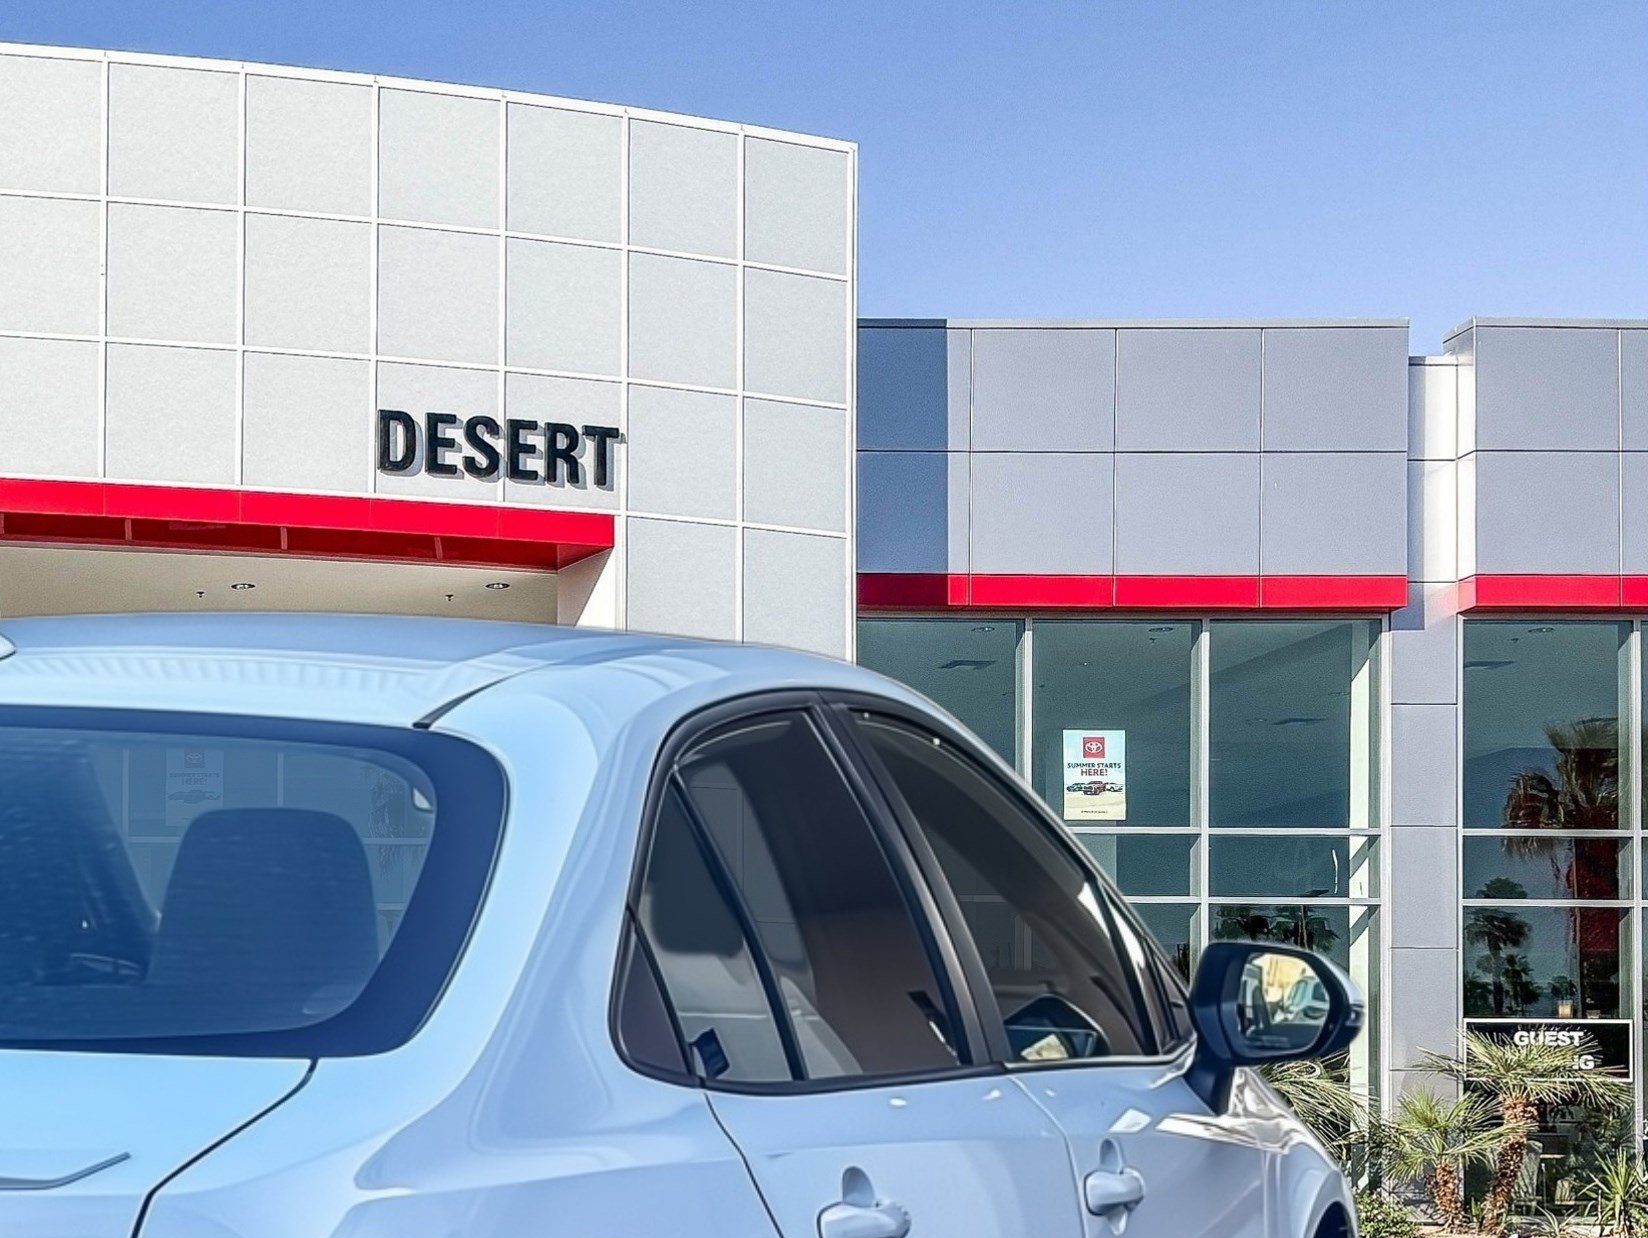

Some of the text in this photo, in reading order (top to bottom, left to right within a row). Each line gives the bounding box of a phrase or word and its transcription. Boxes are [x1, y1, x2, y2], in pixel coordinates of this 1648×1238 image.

[377, 409, 620, 487] DESERT
[1080, 768, 1108, 776] HERE!
[1513, 1030, 1584, 1047] GUEST
